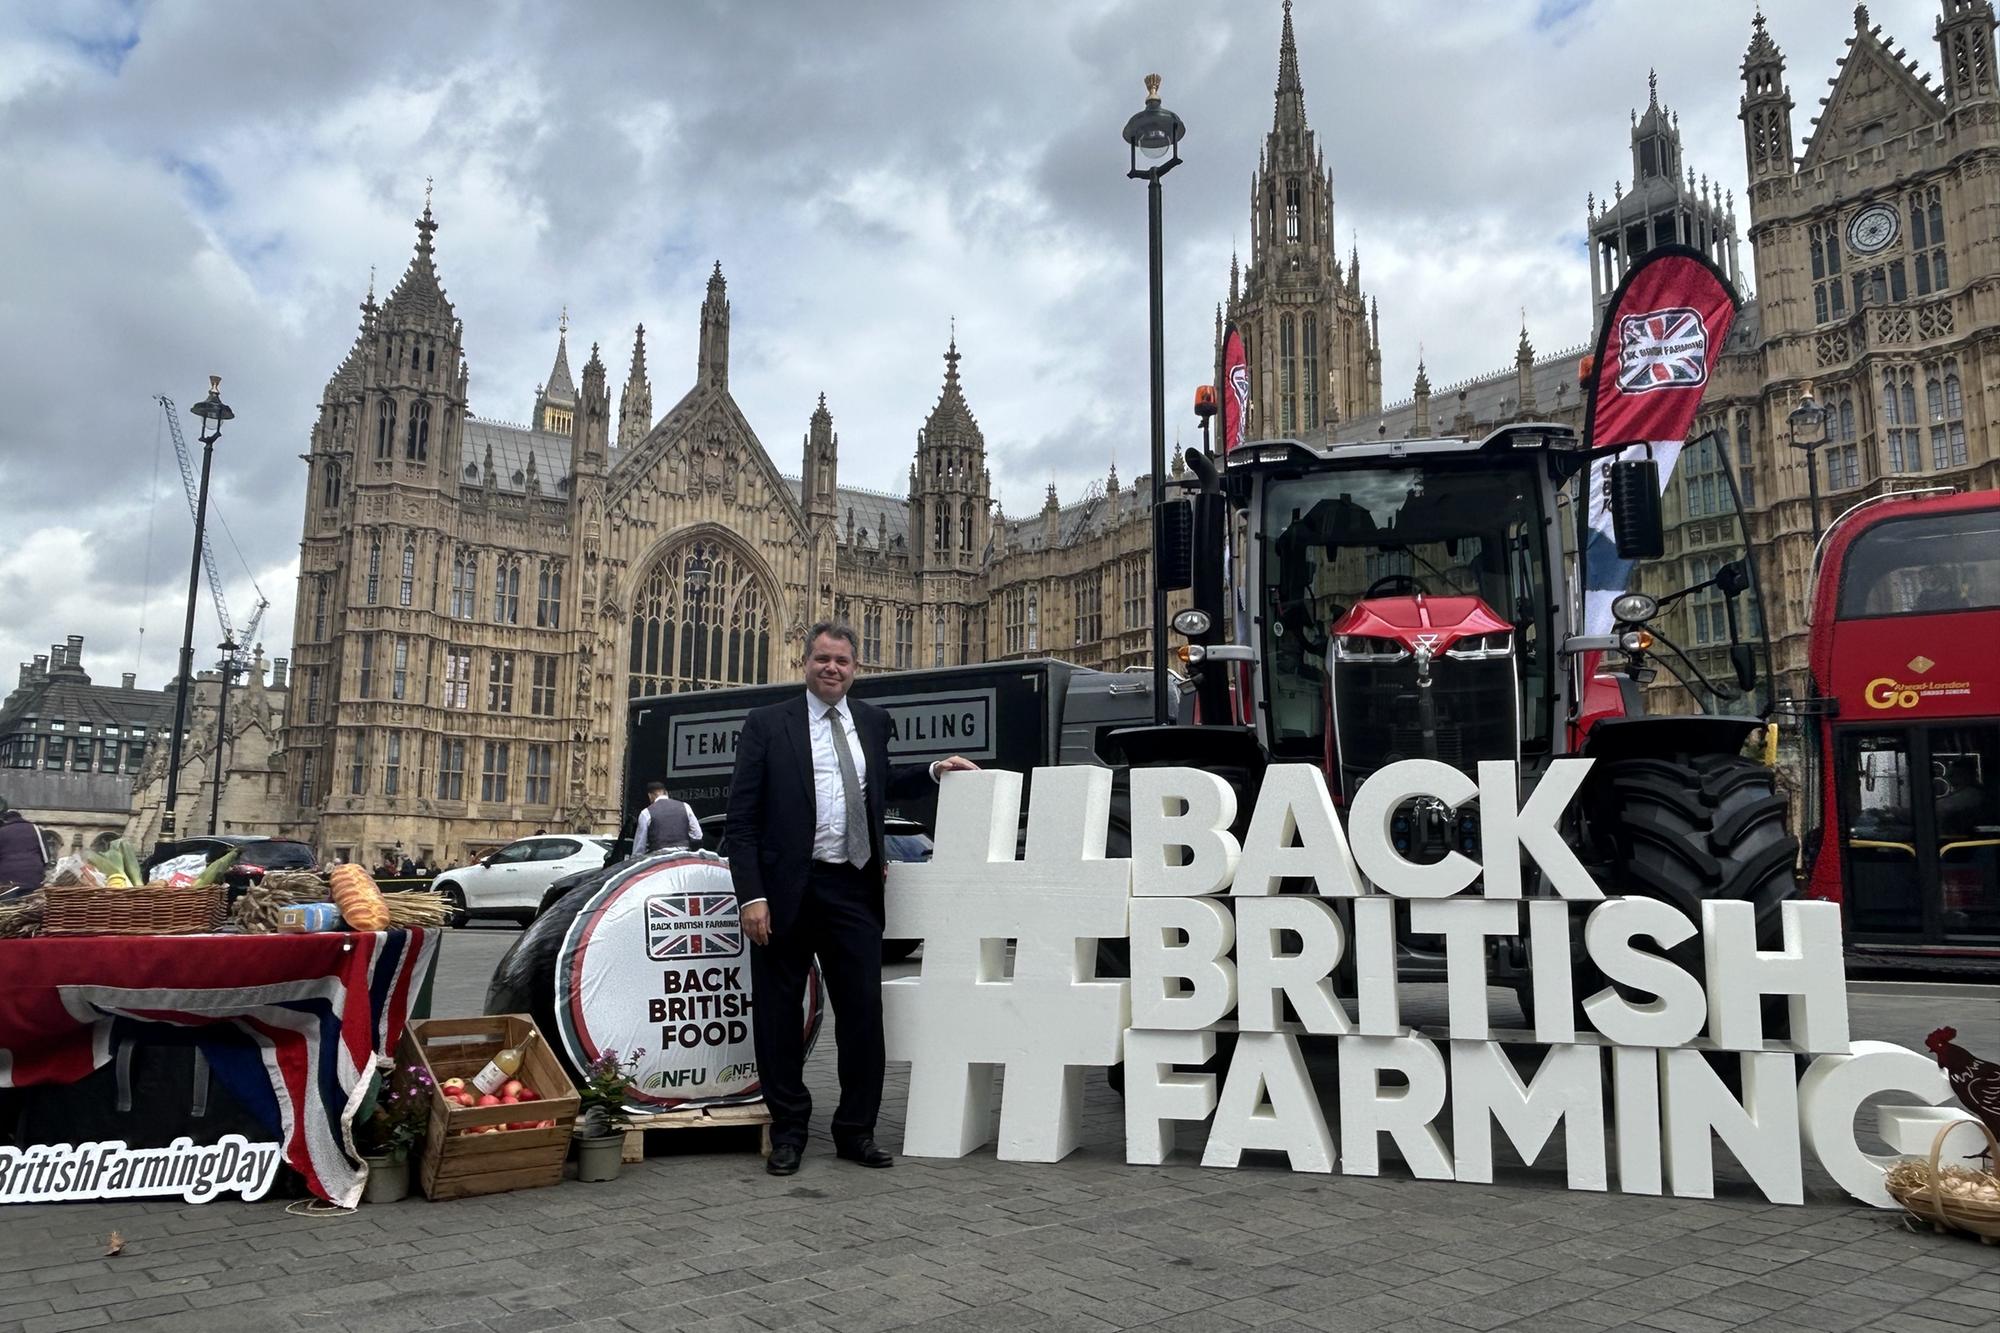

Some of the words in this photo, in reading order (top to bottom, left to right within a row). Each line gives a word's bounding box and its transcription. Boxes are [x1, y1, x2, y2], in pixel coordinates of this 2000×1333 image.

[1864, 677, 1920, 710] Go
[685, 730, 742, 756] TEMP
[888, 712, 976, 742] AILING
[650, 922, 672, 932] BACK
[673, 921, 704, 931] BRITISH
[705, 919, 740, 929] FARMING
[663, 967, 742, 995] BACK
[1129, 896, 1850, 1054] BRITISH
[648, 993, 753, 1023] BRITISH
[661, 1020, 748, 1050] FOOD
[661, 1067, 707, 1088] NFU
[1122, 1028, 1988, 1210] FARMING
